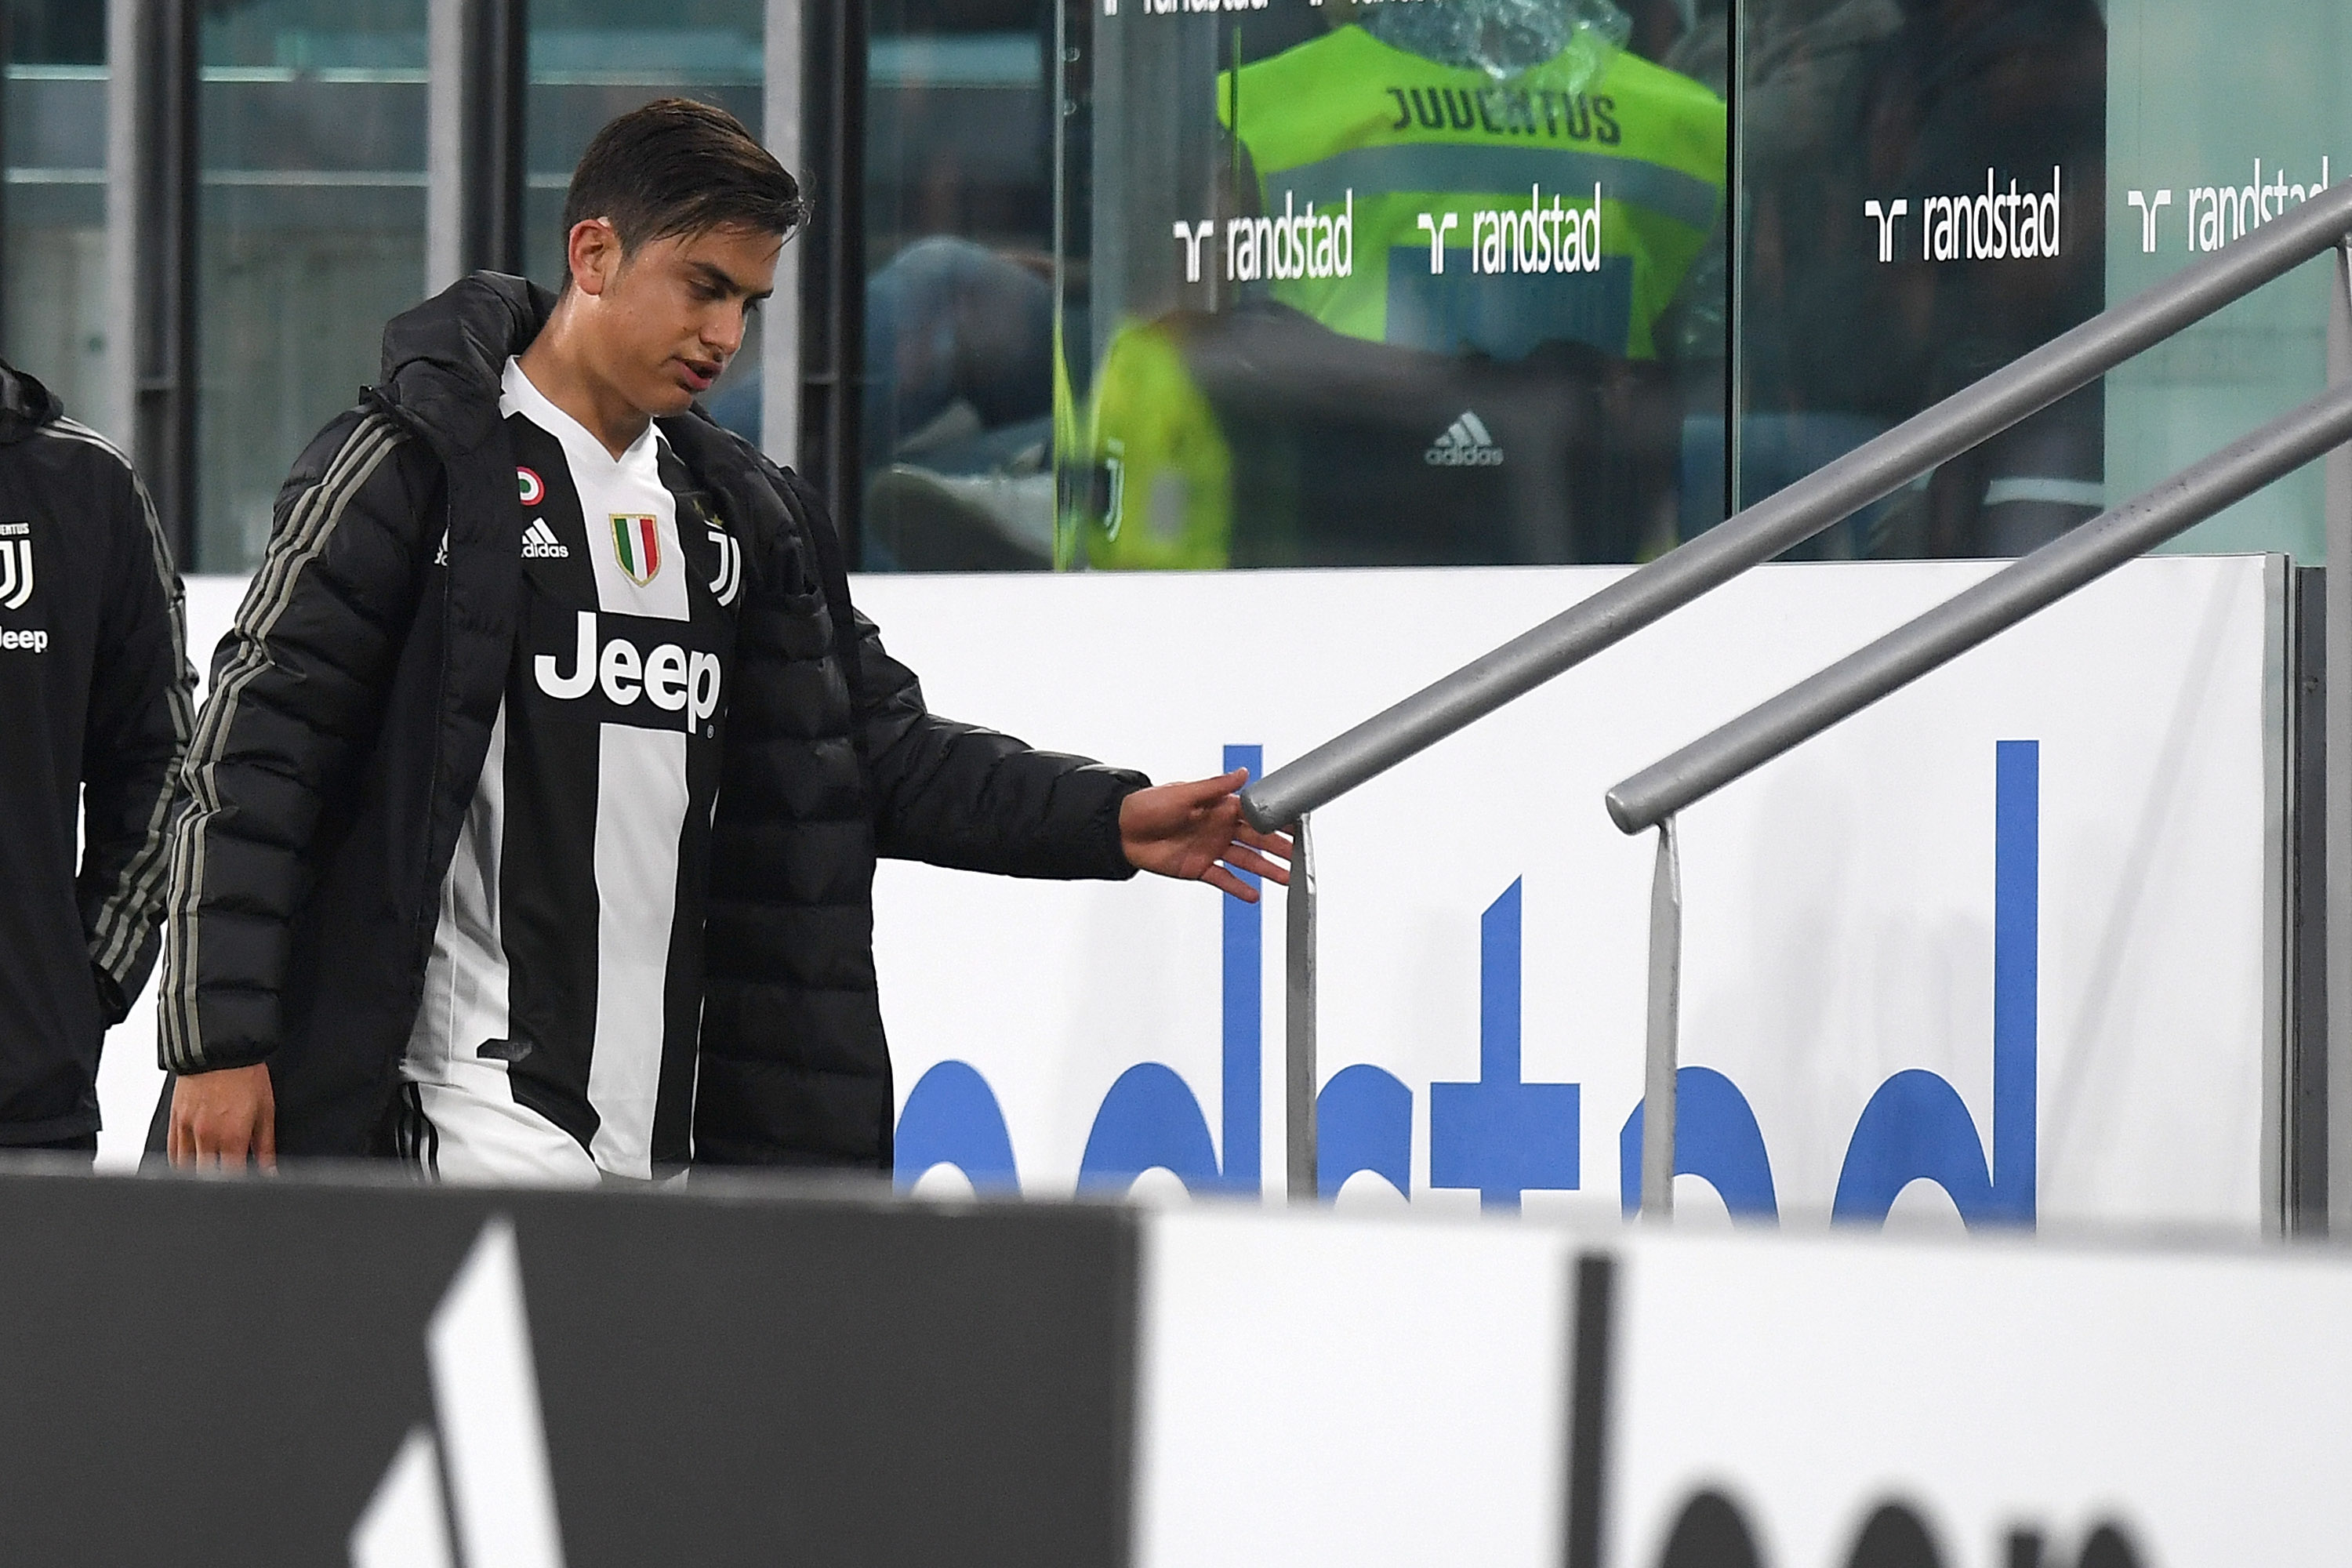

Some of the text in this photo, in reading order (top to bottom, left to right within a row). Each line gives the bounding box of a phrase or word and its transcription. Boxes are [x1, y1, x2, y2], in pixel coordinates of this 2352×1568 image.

[1226, 188, 1353, 282] randstad
[1472, 181, 1601, 274] randstad
[1923, 165, 2060, 261] randstad
[1424, 445, 1504, 466] adidas
[521, 543, 569, 558] didas
[0, 625, 48, 654] eep
[534, 610, 721, 735] Jeep
